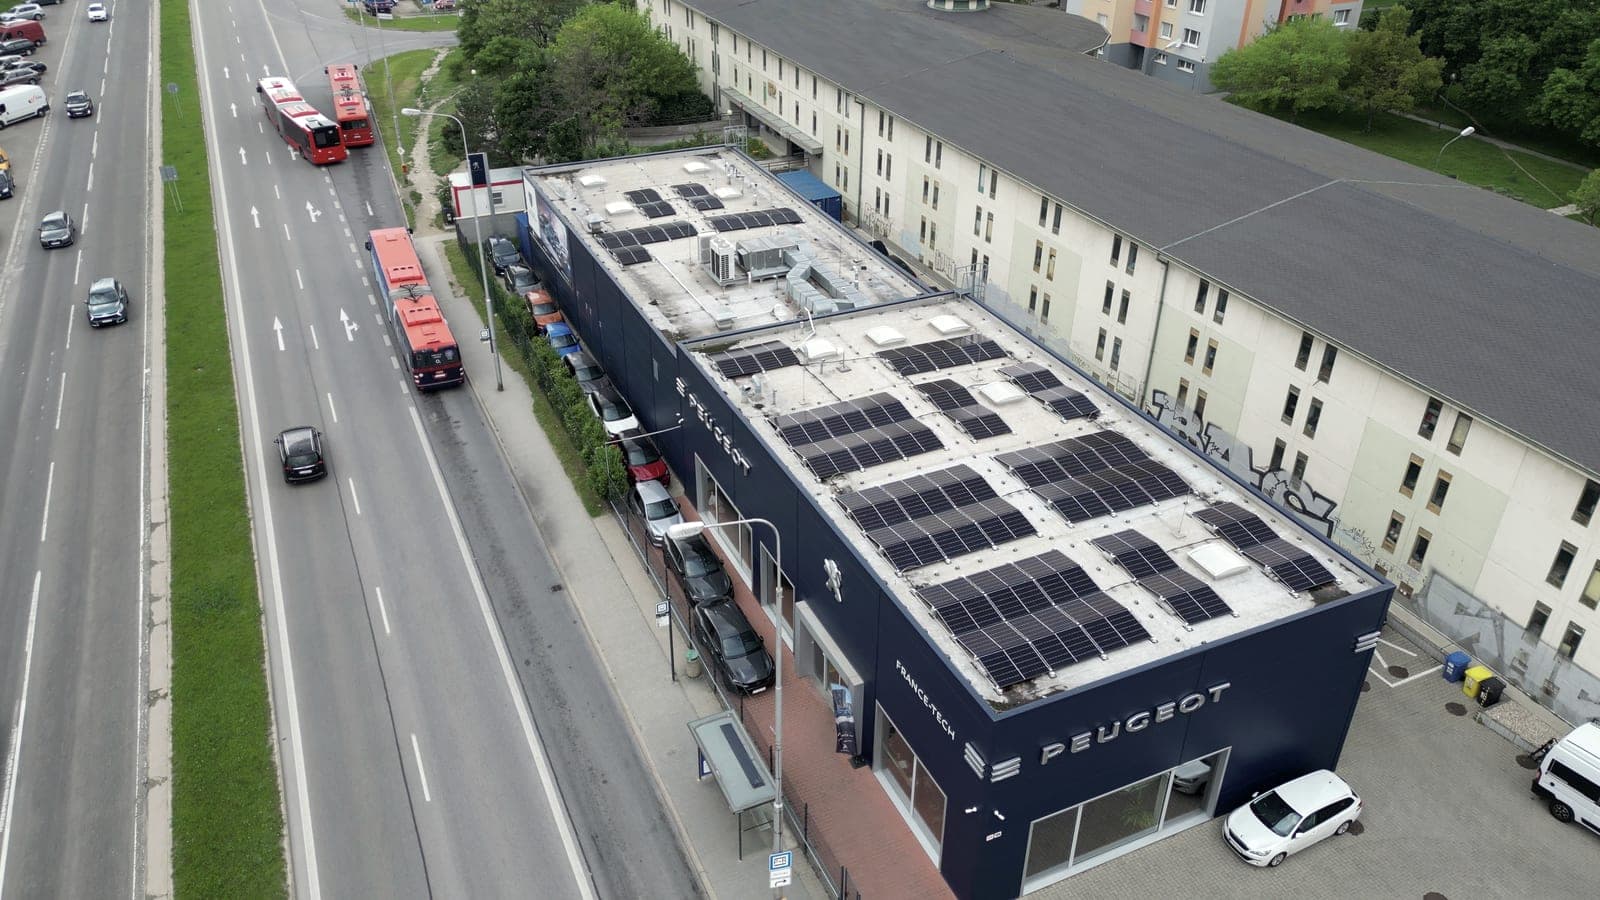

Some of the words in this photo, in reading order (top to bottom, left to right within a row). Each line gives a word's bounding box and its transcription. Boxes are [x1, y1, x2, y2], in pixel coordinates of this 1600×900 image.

[689, 393, 751, 476] PEUGEOT
[896, 659, 955, 741] FRANCE-TECH
[1041, 682, 1231, 765] PEUGEOT
